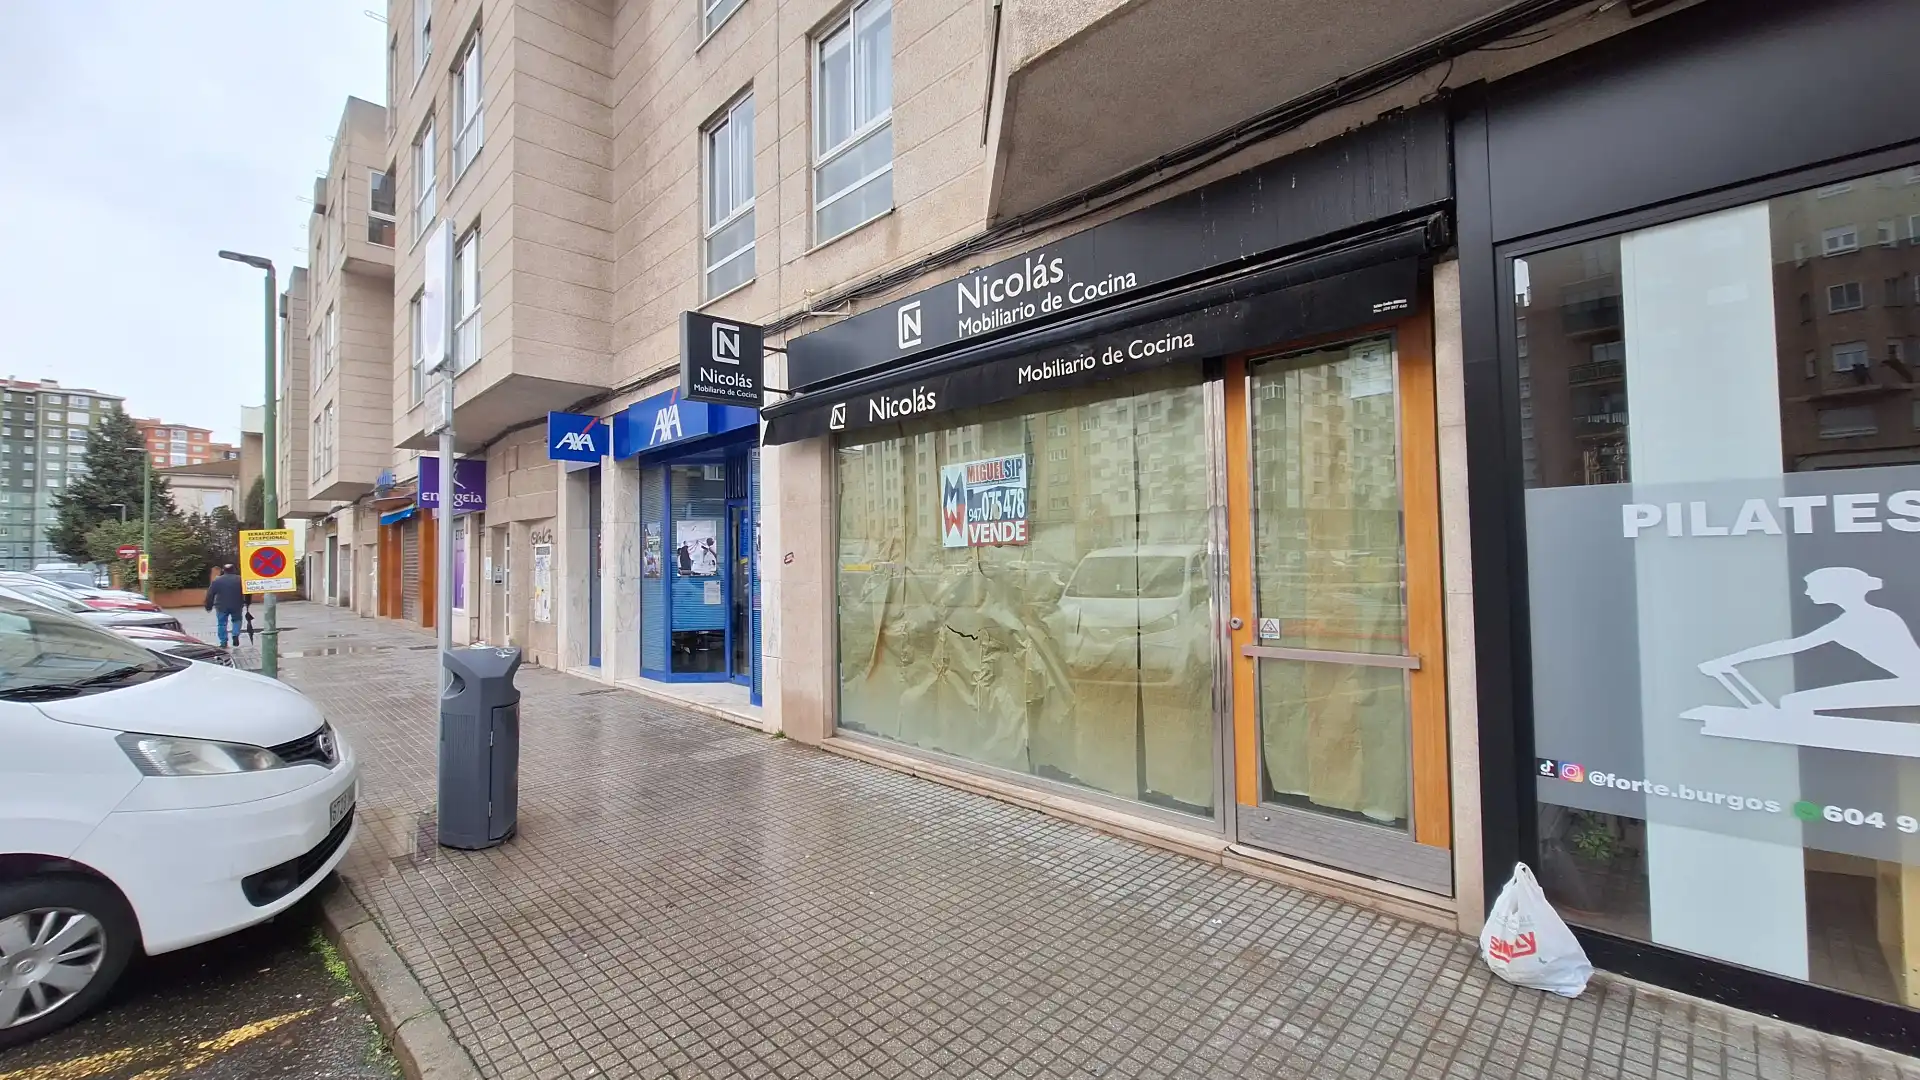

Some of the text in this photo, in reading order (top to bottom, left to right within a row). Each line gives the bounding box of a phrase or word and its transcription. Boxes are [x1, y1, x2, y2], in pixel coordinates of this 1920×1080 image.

[957, 253, 1064, 314] Nicolás
[958, 272, 1138, 338] Mobiliario de Cocina
[1018, 333, 1195, 384] Mobiliario de Cocina
[693, 383, 758, 399] Mobiliario de Cocina
[700, 366, 753, 389] Nicolás
[869, 386, 936, 422] Nicolás
[555, 431, 596, 452] AXA
[649, 403, 683, 446] AXA
[421, 491, 483, 507] engeia
[1622, 490, 1920, 538] PILATES
[969, 520, 1026, 544] VENDE
[1588, 770, 1781, 813] @forte.burgos
[1822, 805, 1887, 829] 604
